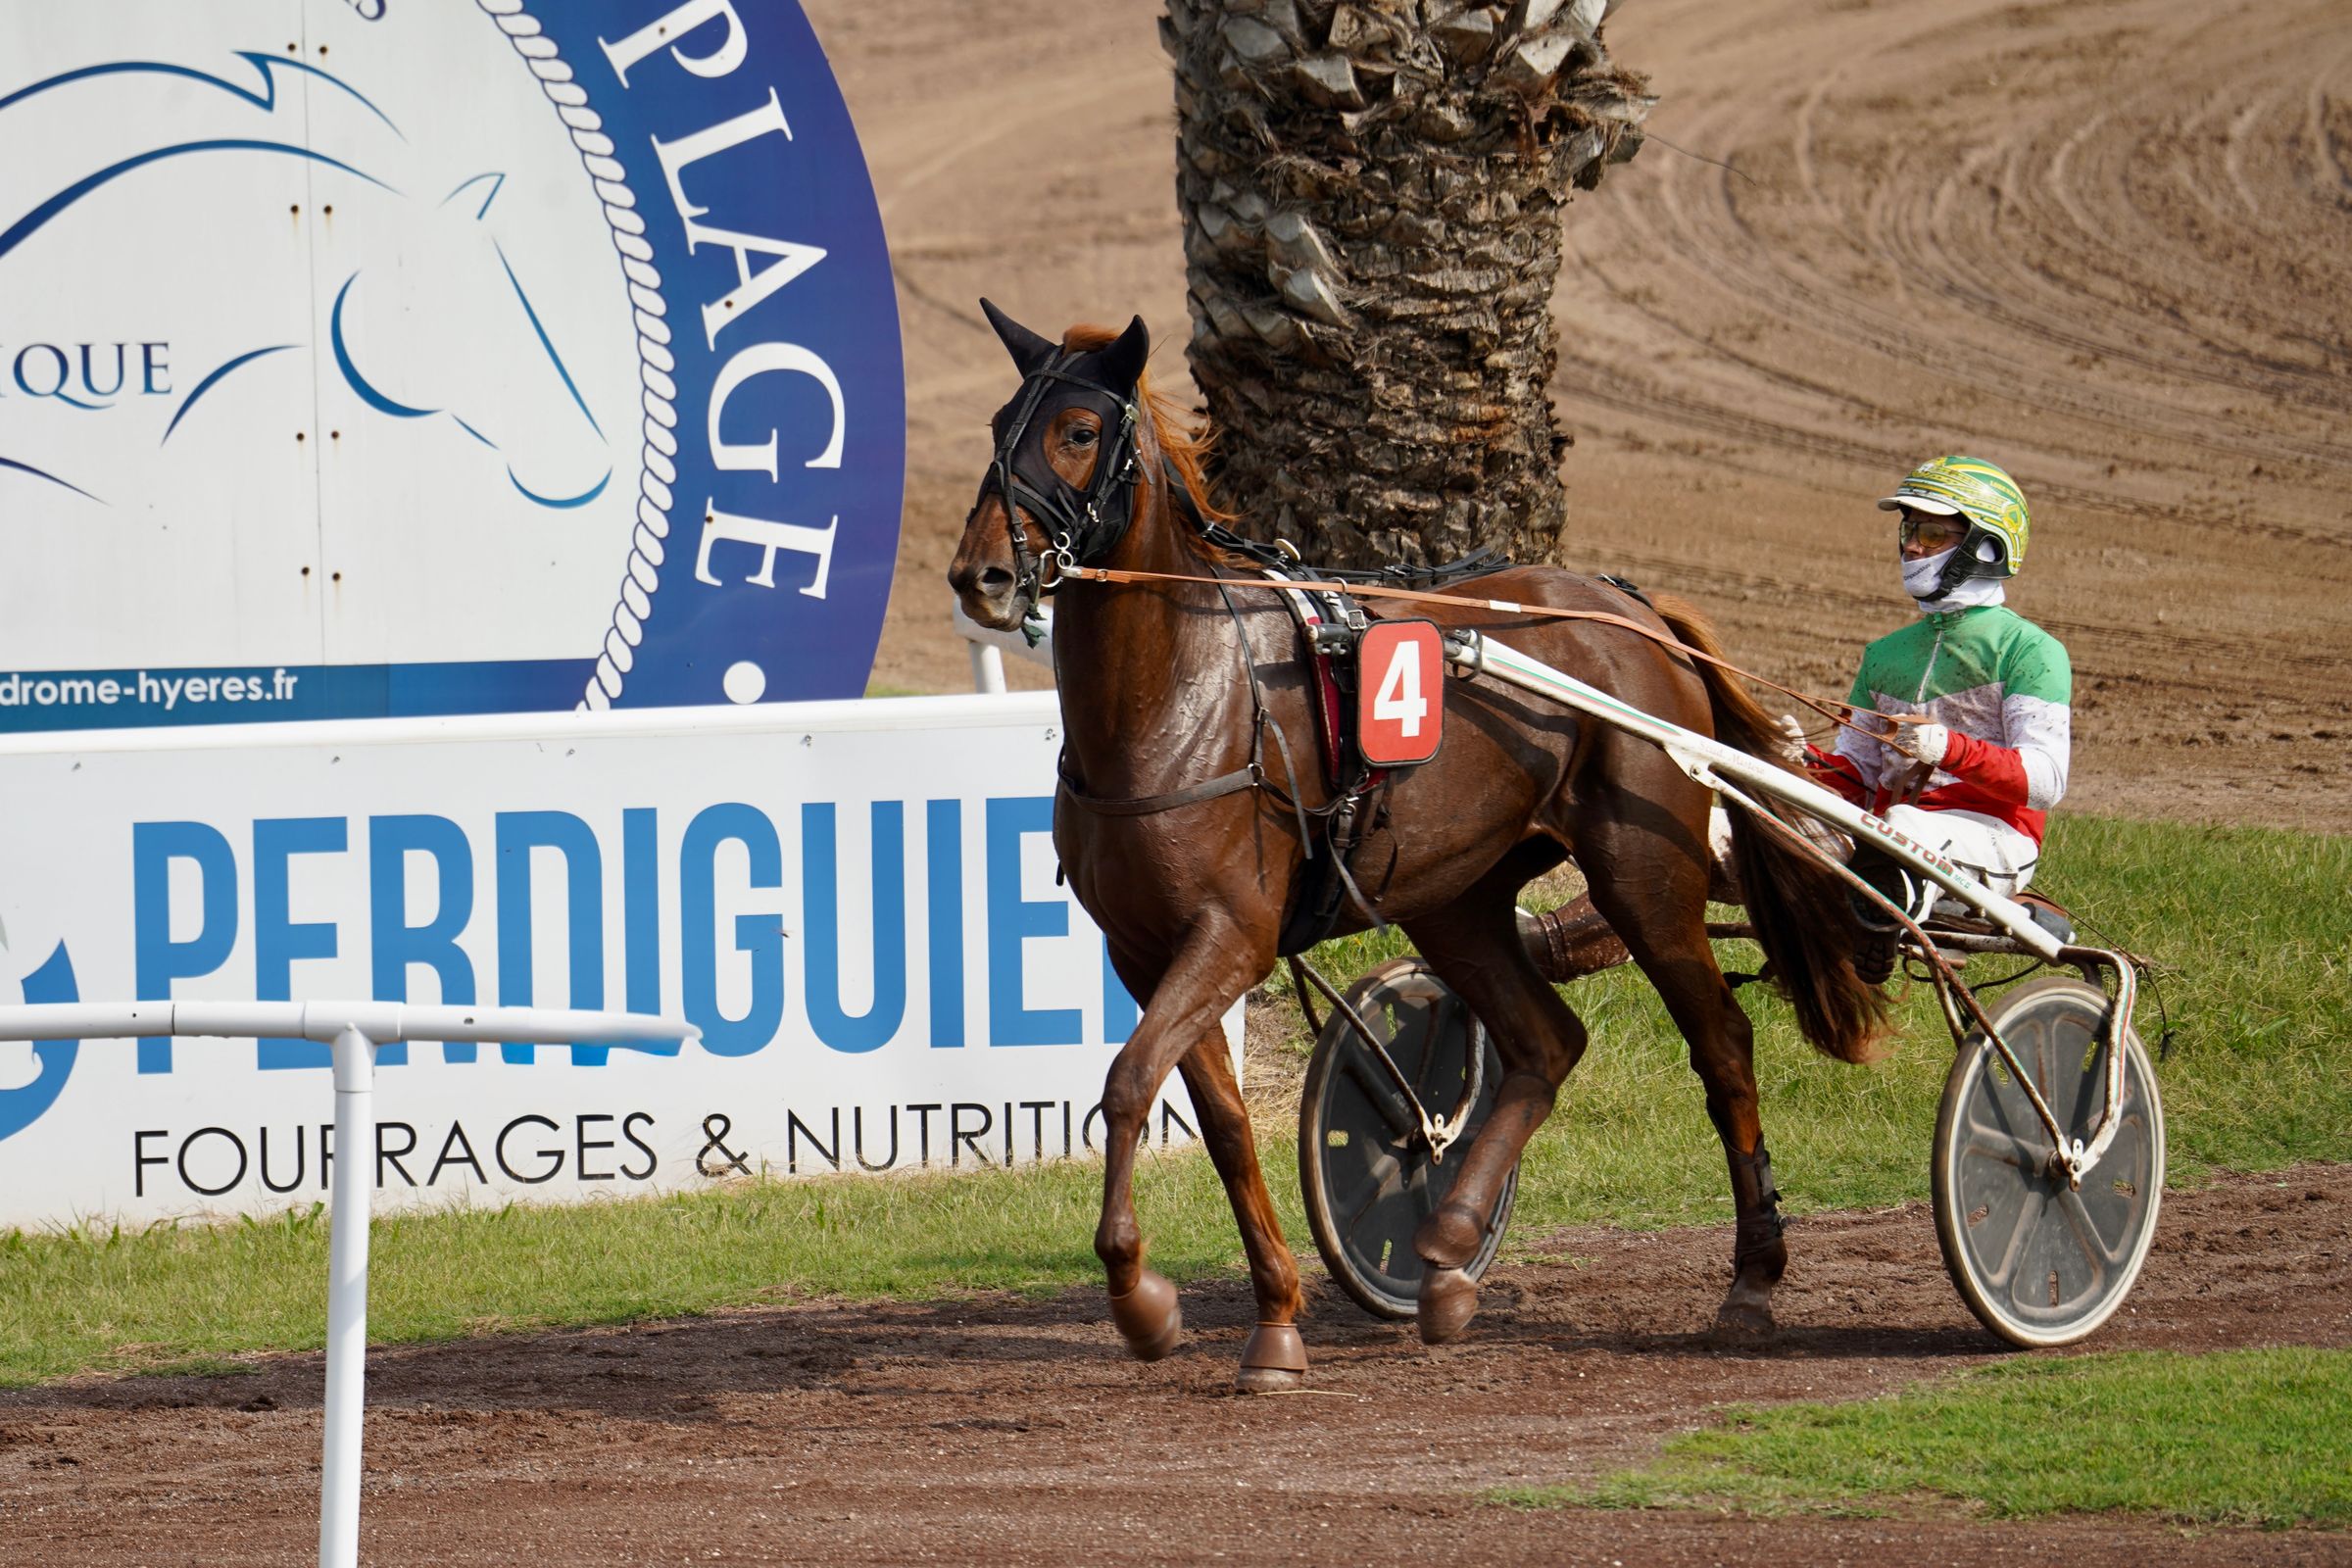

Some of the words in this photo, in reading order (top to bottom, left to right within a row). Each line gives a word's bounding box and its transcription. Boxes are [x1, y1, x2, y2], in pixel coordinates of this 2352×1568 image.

[598, 0, 846, 600] PLAGE
[0, 342, 172, 410] QUE
[0, 667, 299, 710] drome-hyeres.fr
[1373, 640, 1428, 737] 4
[132, 796, 1145, 1075] PERDIGUIE
[696, 1112, 753, 1176] &
